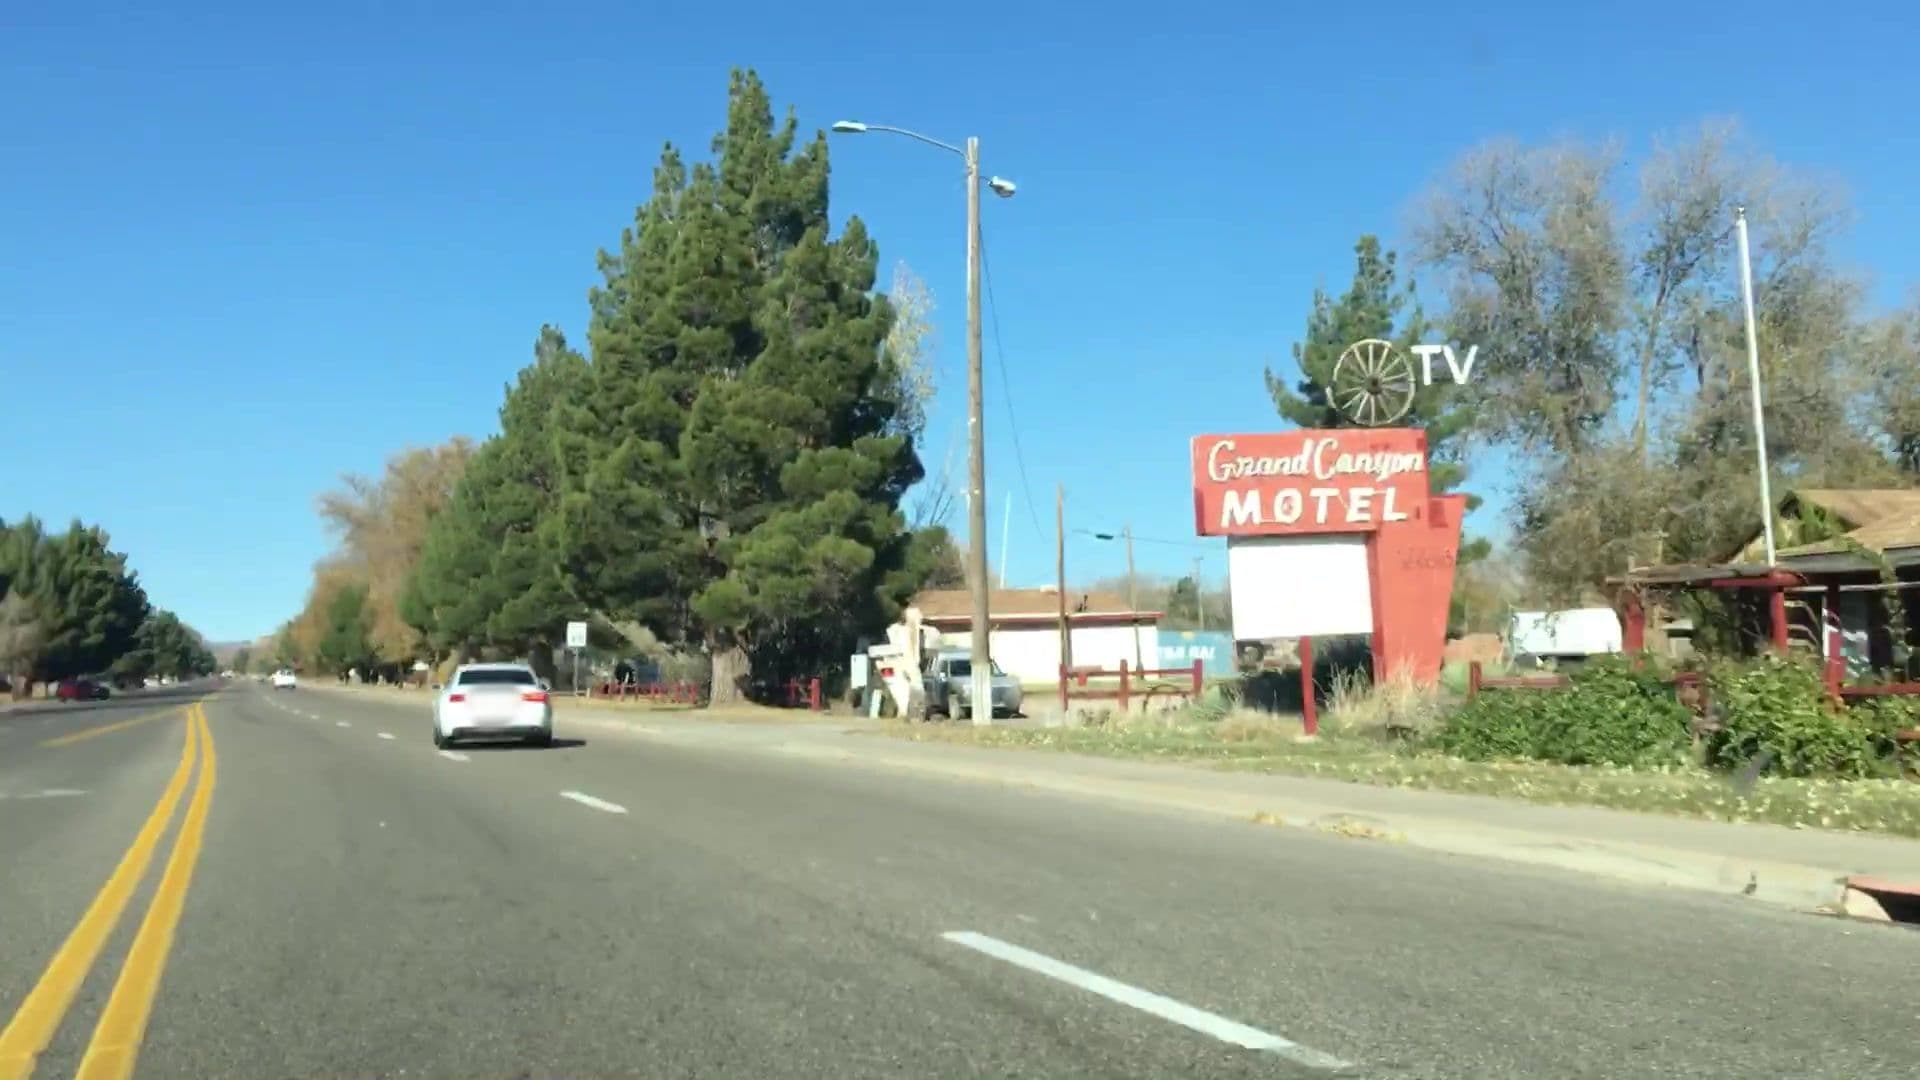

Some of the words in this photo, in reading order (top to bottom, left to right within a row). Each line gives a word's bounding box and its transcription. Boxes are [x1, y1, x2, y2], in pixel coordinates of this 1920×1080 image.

[1411, 345, 1478, 385] TV
[1208, 439, 1313, 482] Grand
[1314, 438, 1424, 481] Canyon
[1221, 487, 1408, 528] MOTEL
